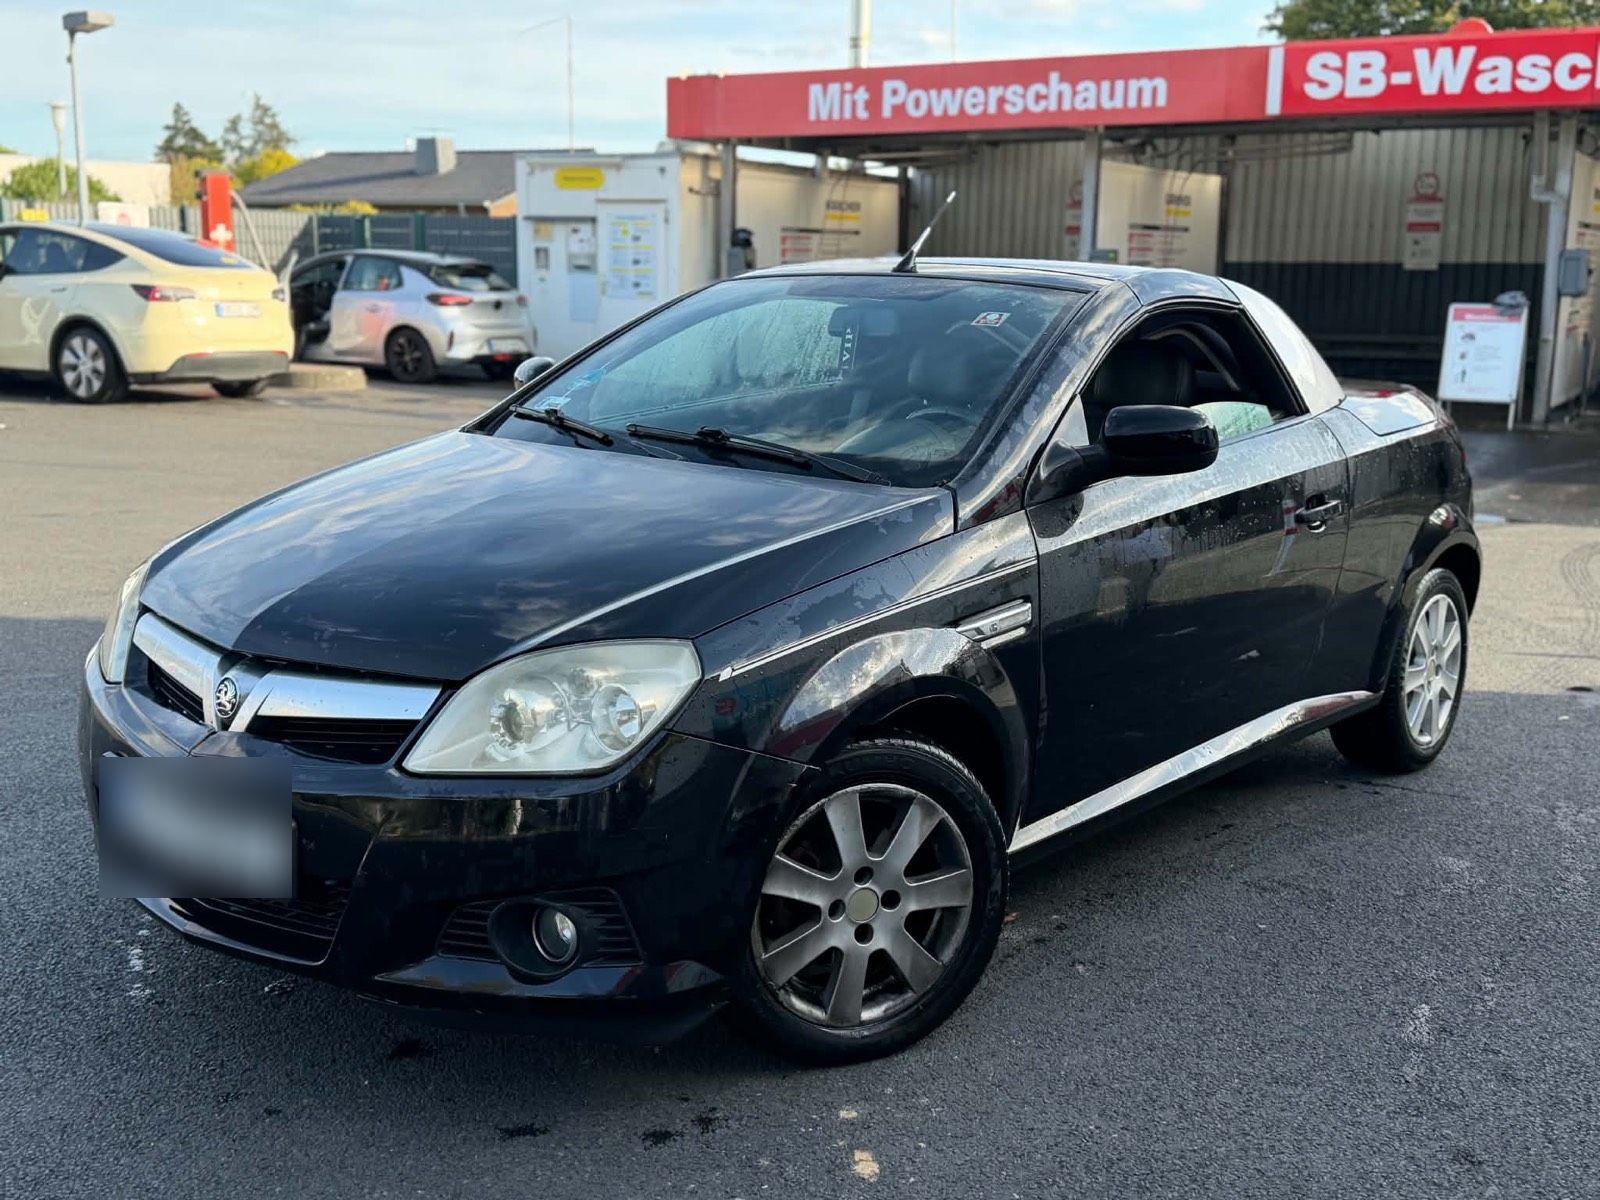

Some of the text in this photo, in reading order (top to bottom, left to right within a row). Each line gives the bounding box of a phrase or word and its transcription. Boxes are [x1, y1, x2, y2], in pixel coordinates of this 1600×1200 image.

[808, 71, 1168, 122] Mit Powerschaum
[1303, 45, 1600, 100] SB-Wasc
[842, 328, 853, 362] VIP
